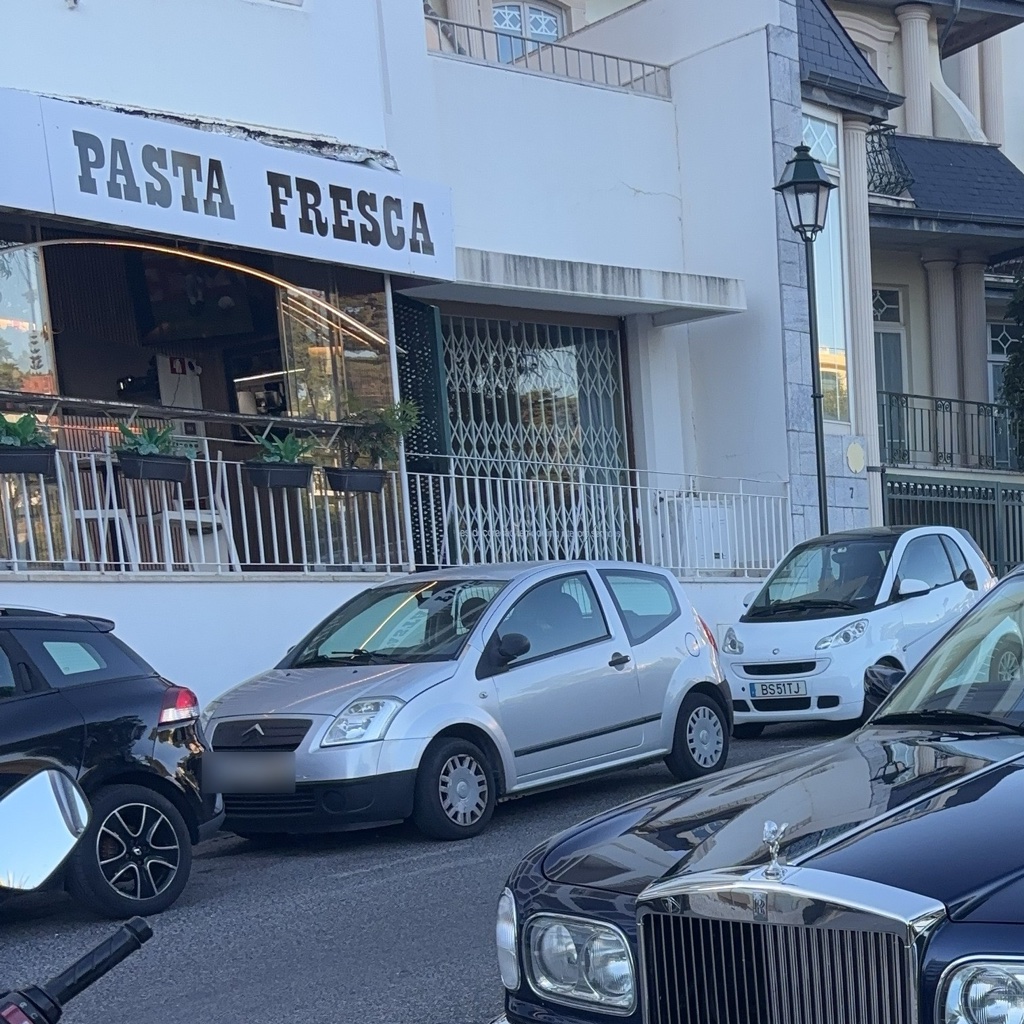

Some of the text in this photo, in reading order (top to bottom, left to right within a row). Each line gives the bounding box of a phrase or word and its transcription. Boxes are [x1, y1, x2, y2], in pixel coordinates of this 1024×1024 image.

[72, 130, 434, 255] PASTA FRESCA
[849, 486, 854, 499] 7
[761, 683, 800, 696] BS51TJ
